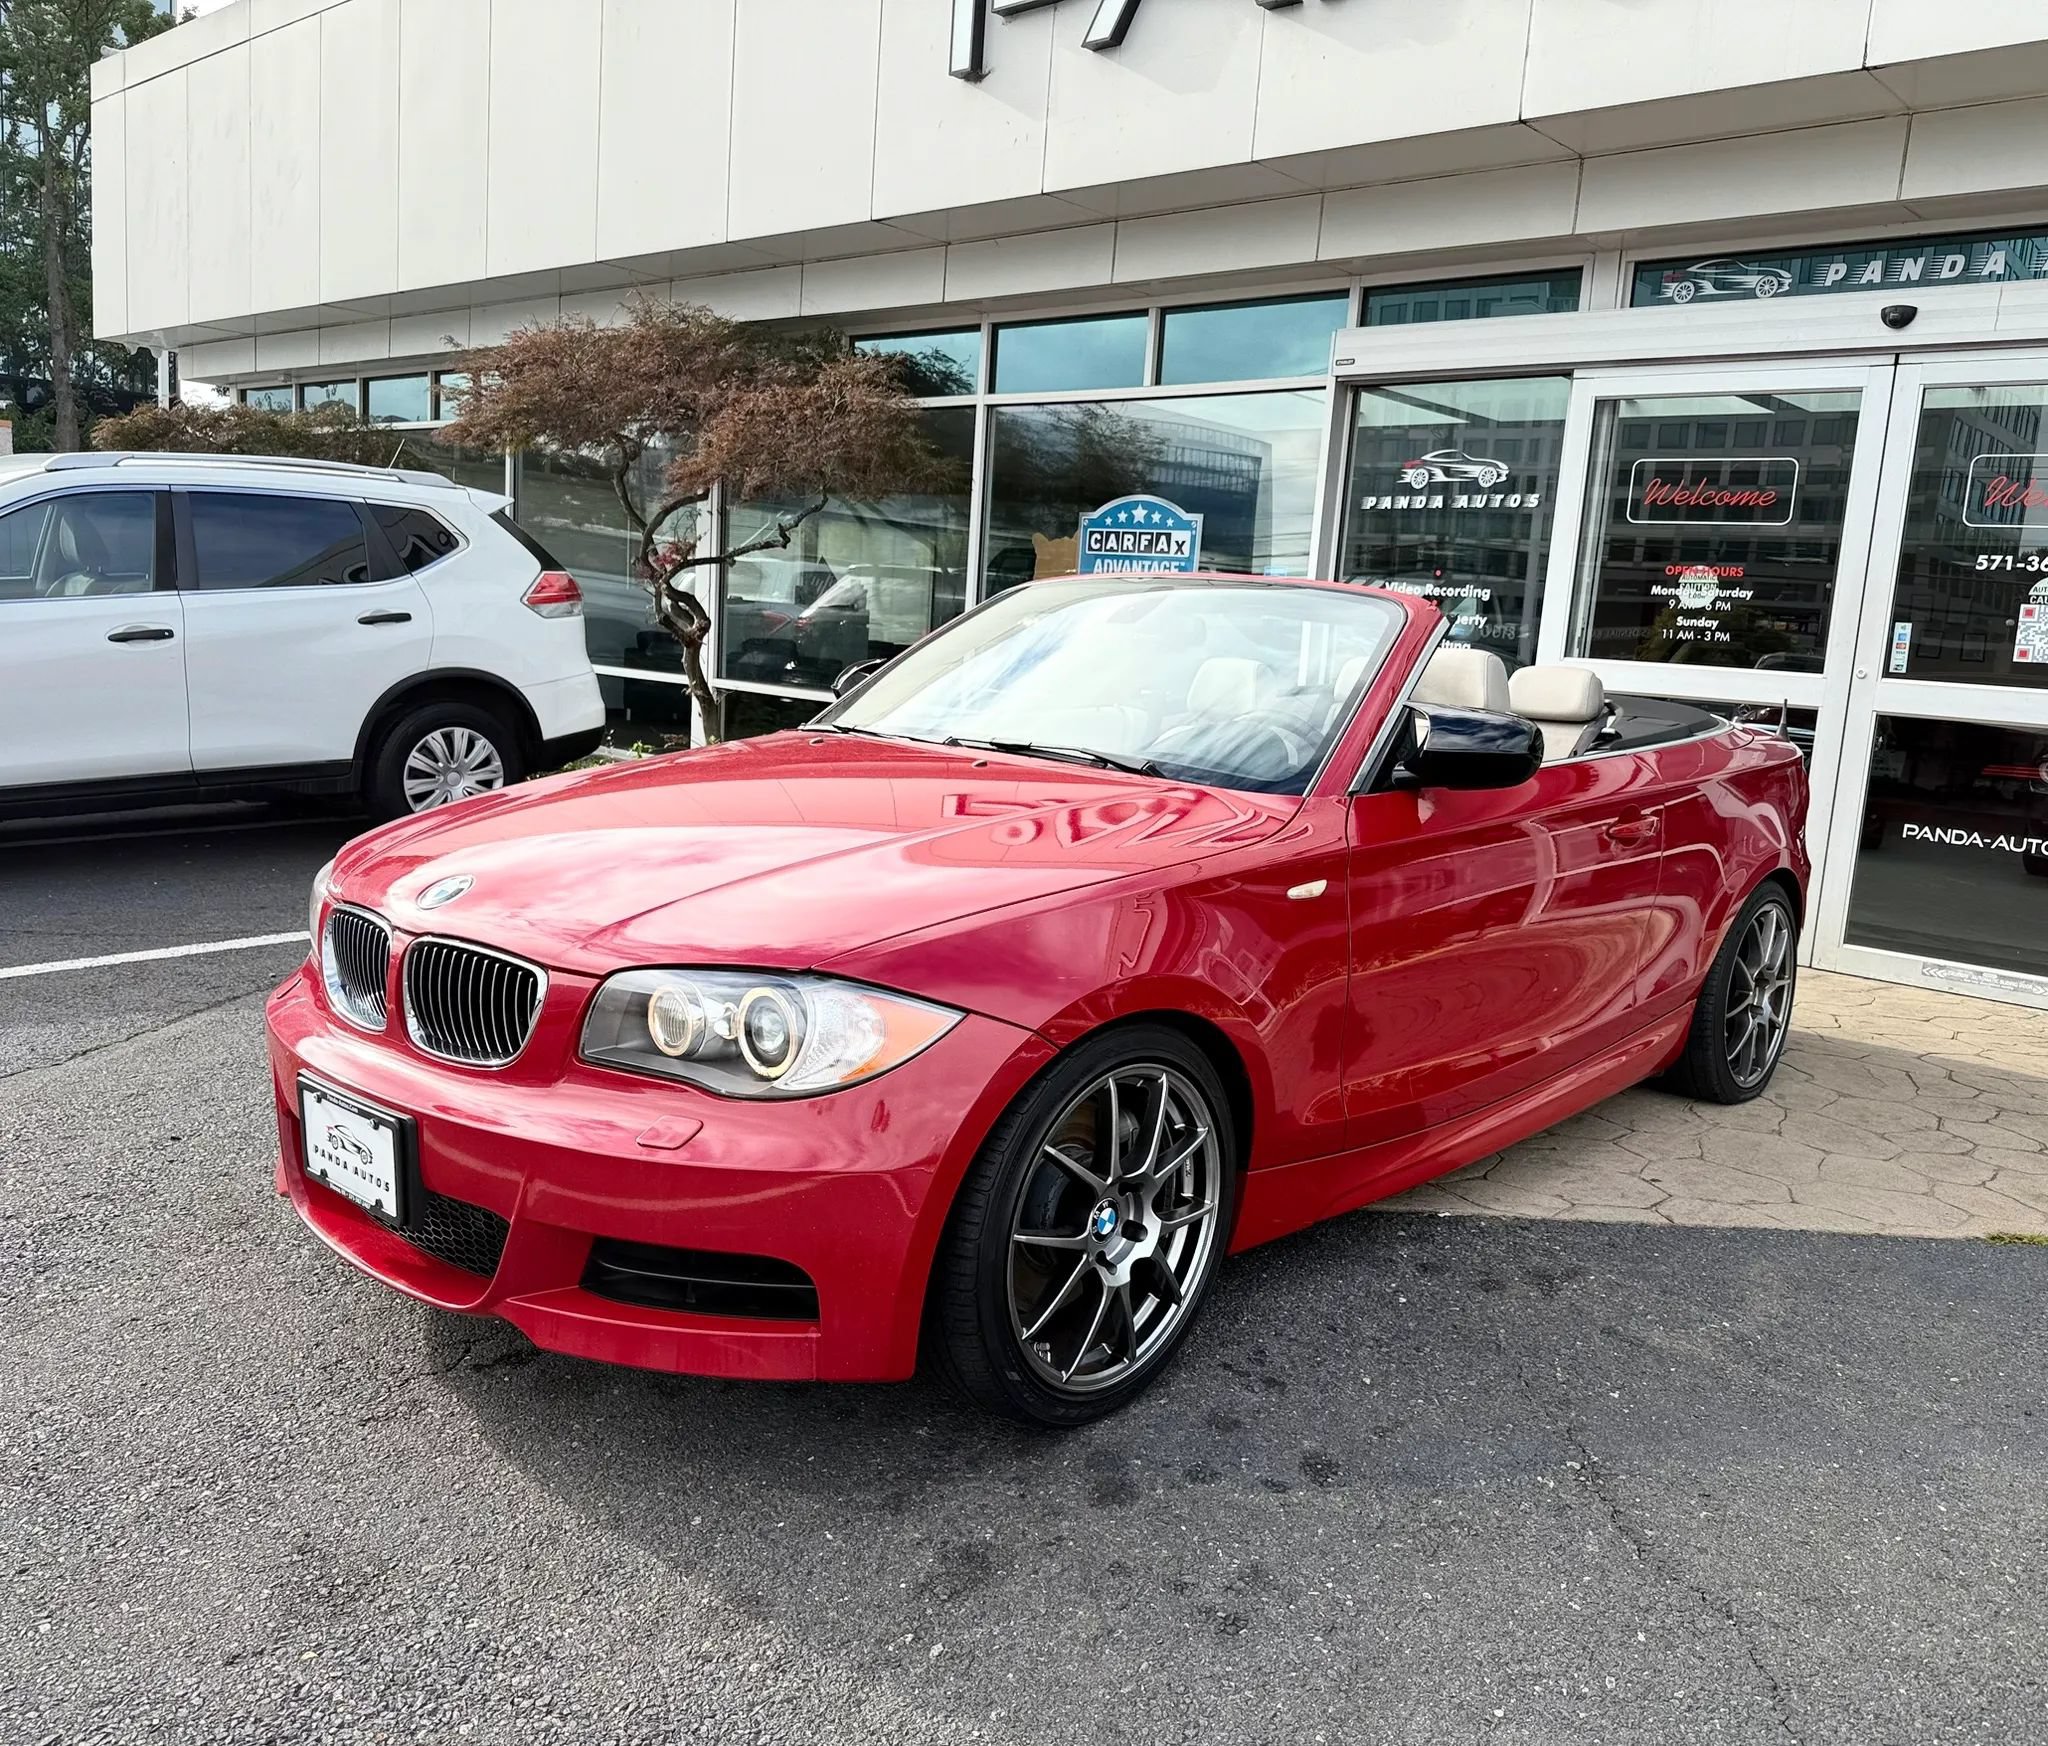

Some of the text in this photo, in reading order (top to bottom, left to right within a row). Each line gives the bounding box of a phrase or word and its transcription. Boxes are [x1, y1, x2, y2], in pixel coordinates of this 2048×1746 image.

[1812, 250, 2006, 287] PANDA
[1361, 493, 1540, 509] PANDA AUTOS
[1643, 476, 1777, 506] Welcome
[1088, 531, 1187, 555] CARFAX
[1385, 581, 1491, 601] Video Recording
[1668, 599, 1676, 609] 9
[1715, 600, 1731, 611] PM
[1676, 616, 1719, 630] Sunday
[1662, 629, 1673, 639] 11
[1676, 630, 1694, 640] AM
[1704, 631, 1711, 641] 3
[1714, 632, 1730, 642] PM
[313, 1144, 390, 1192] PANDA AUTOS
